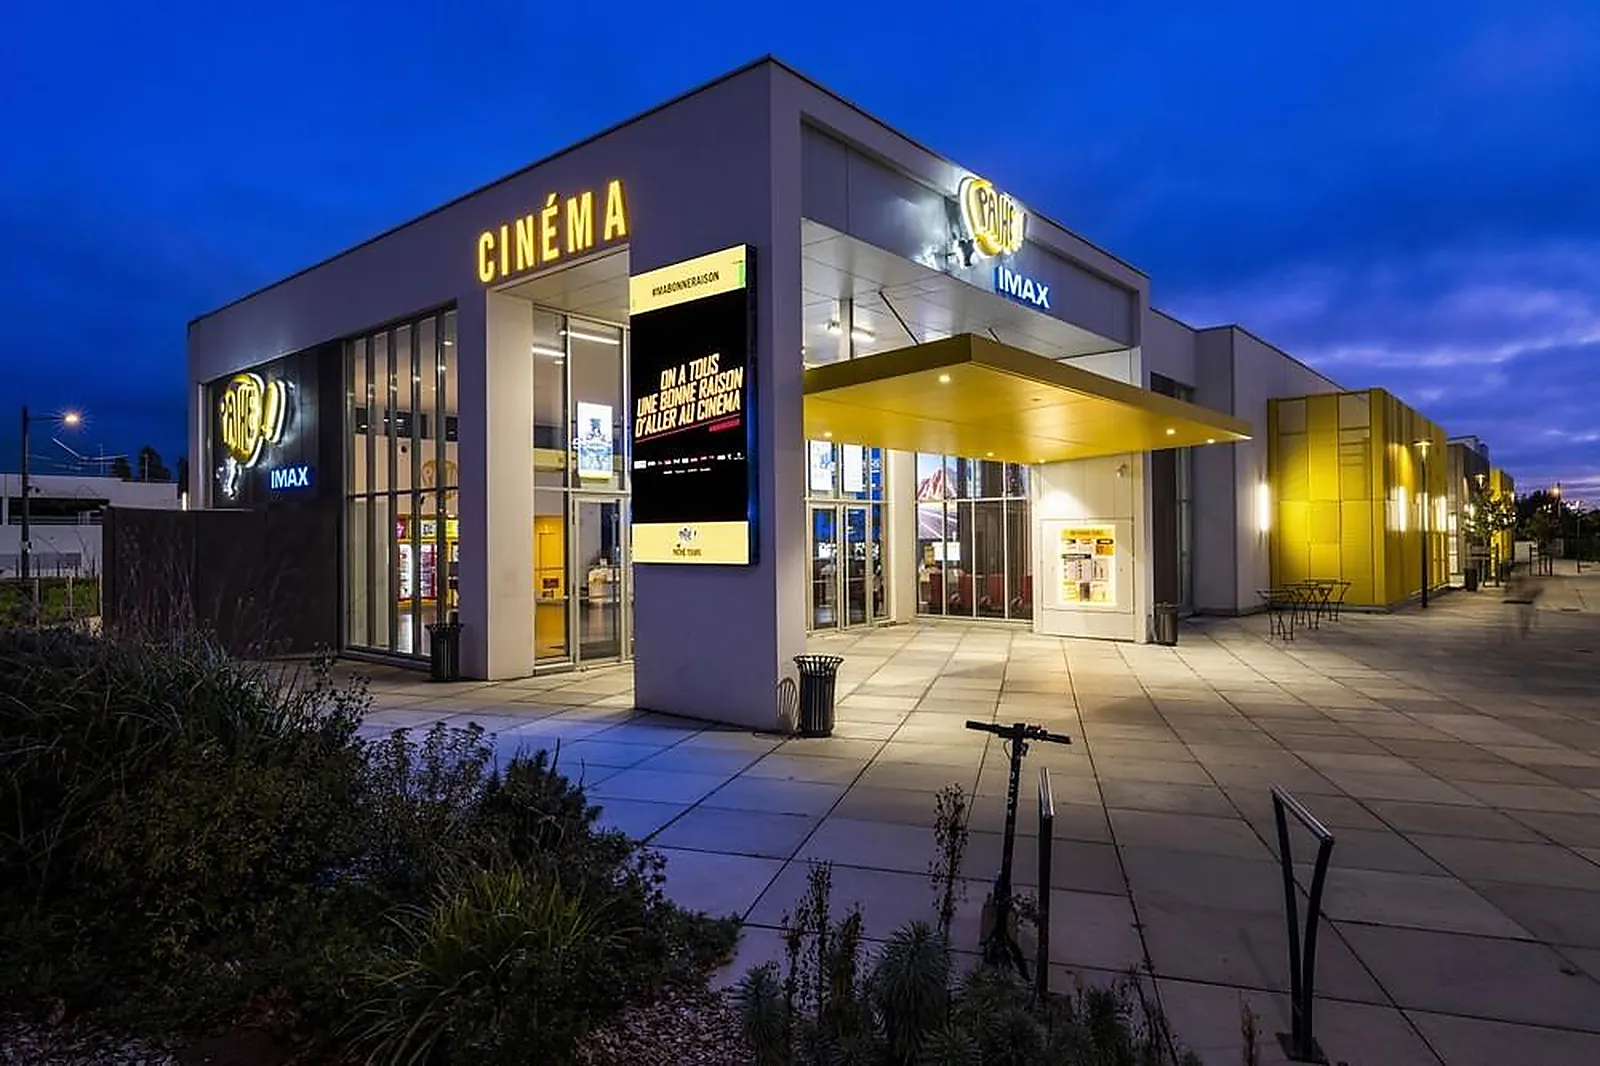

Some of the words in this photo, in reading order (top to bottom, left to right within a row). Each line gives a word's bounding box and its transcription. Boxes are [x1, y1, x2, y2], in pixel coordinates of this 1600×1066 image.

[479, 180, 626, 282] CINÉMA
[652, 271, 720, 298] #MABONNERAISON
[999, 266, 1050, 309] IMAX
[661, 367, 677, 390] ON
[678, 364, 687, 385] A
[689, 353, 720, 381] TOUS
[637, 393, 659, 417] UNE
[660, 382, 698, 411] BONNE
[699, 367, 744, 399] RAISON
[635, 408, 678, 437] D'ALLER
[678, 403, 696, 426] AU
[271, 466, 309, 489] IMAX
